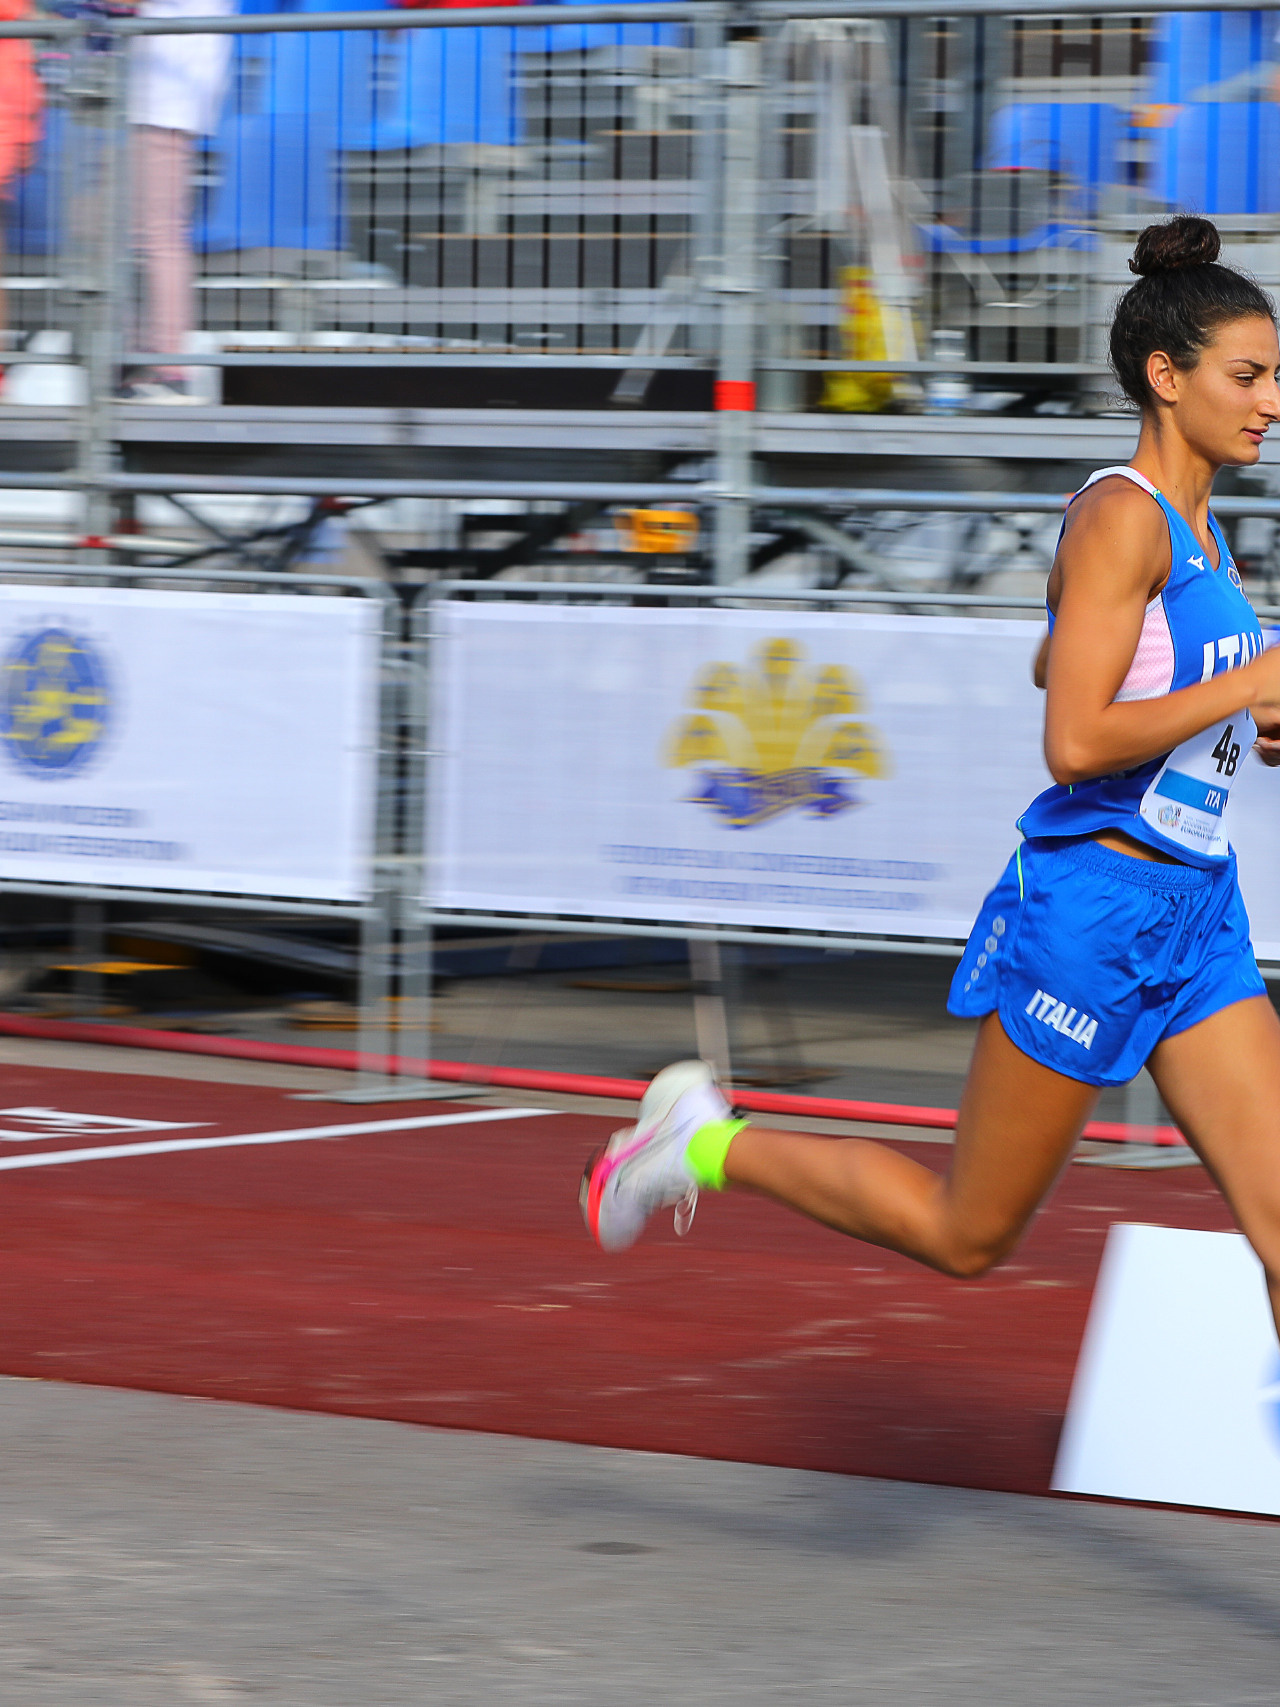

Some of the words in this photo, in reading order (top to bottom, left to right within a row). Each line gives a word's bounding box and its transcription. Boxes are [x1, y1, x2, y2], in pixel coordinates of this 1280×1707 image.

[1211, 724, 1241, 776] 4B
[1204, 789, 1221, 809] ITA
[1025, 988, 1099, 1051] ITALIA
